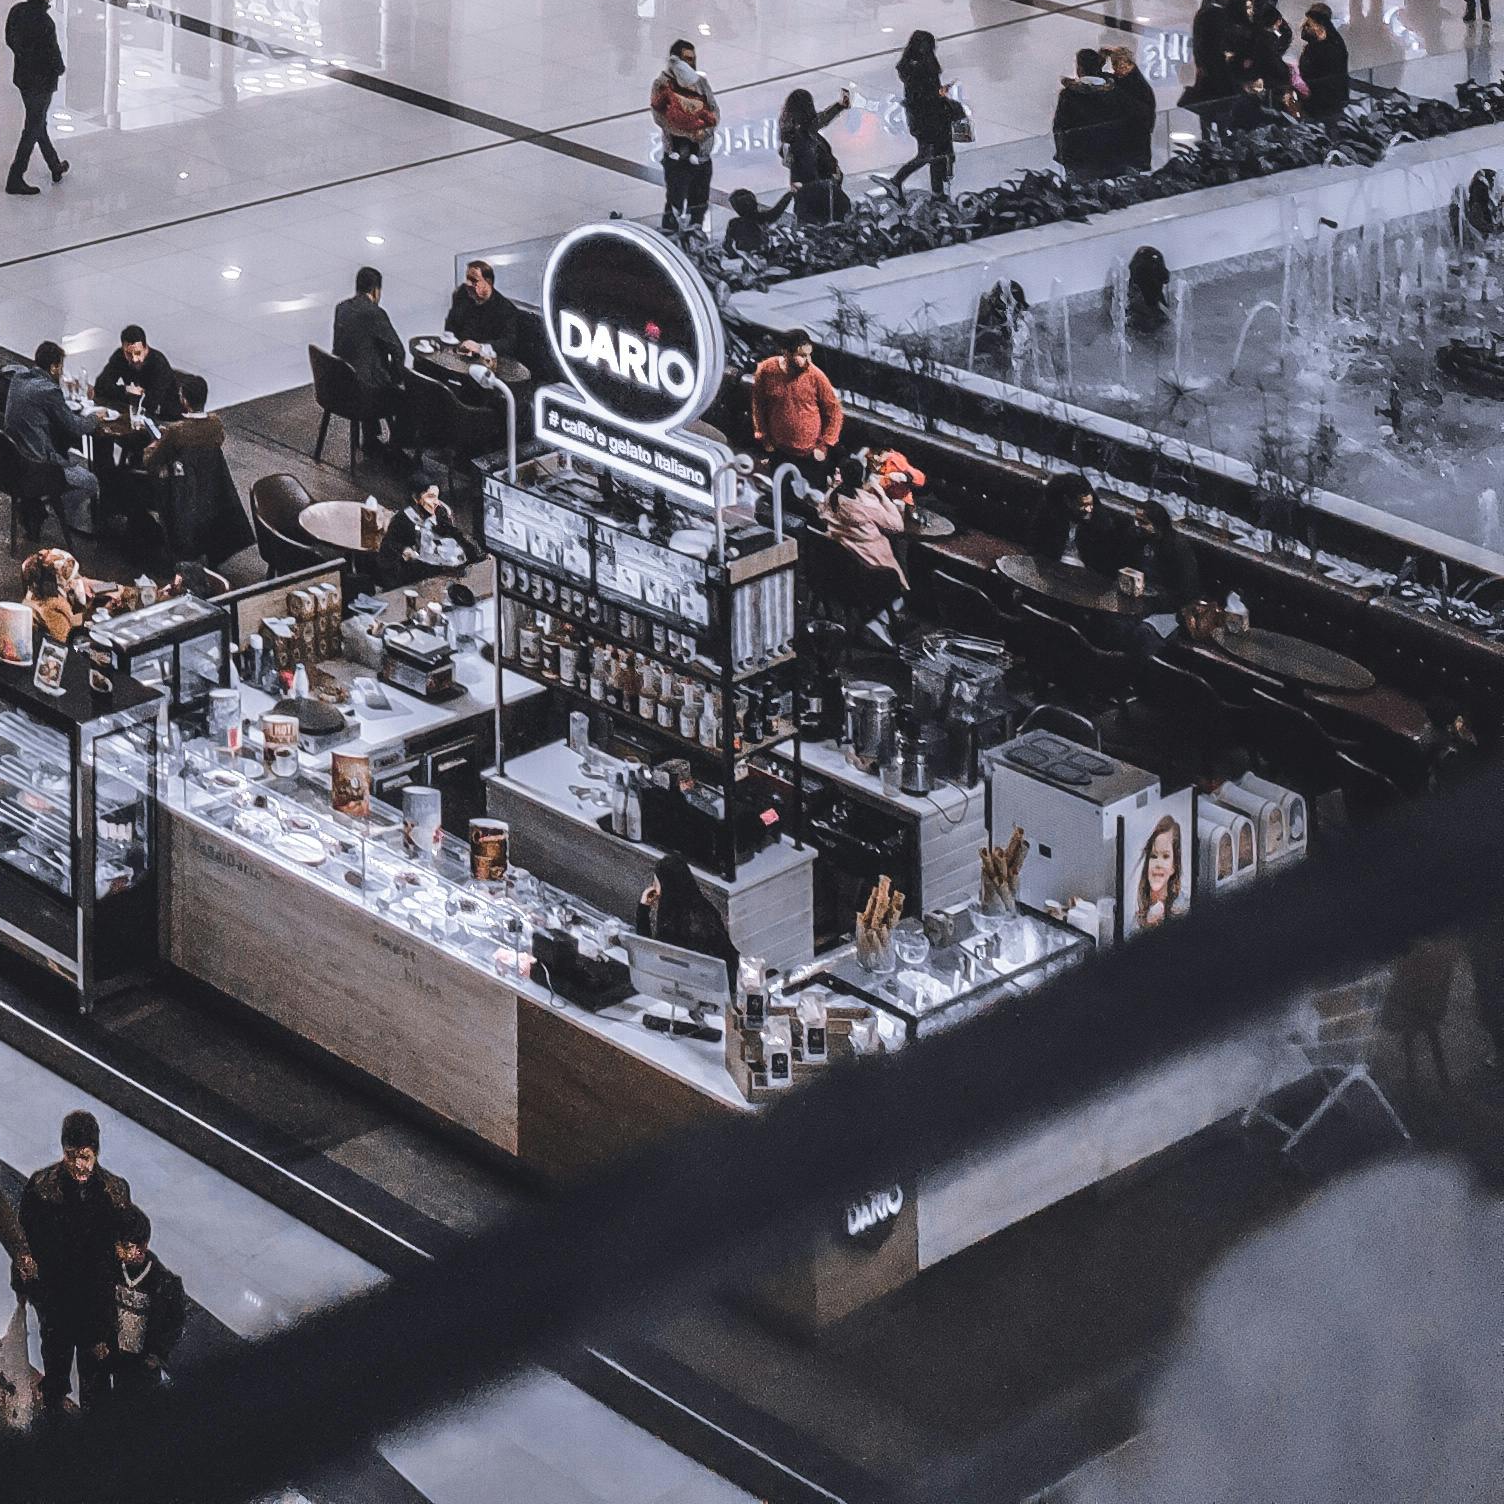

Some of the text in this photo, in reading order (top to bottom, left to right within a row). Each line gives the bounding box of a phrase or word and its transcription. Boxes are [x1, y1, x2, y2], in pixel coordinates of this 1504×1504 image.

[559, 310, 695, 399] DARIO
[608, 436, 653, 465] gelato
[654, 453, 706, 486] italiano
